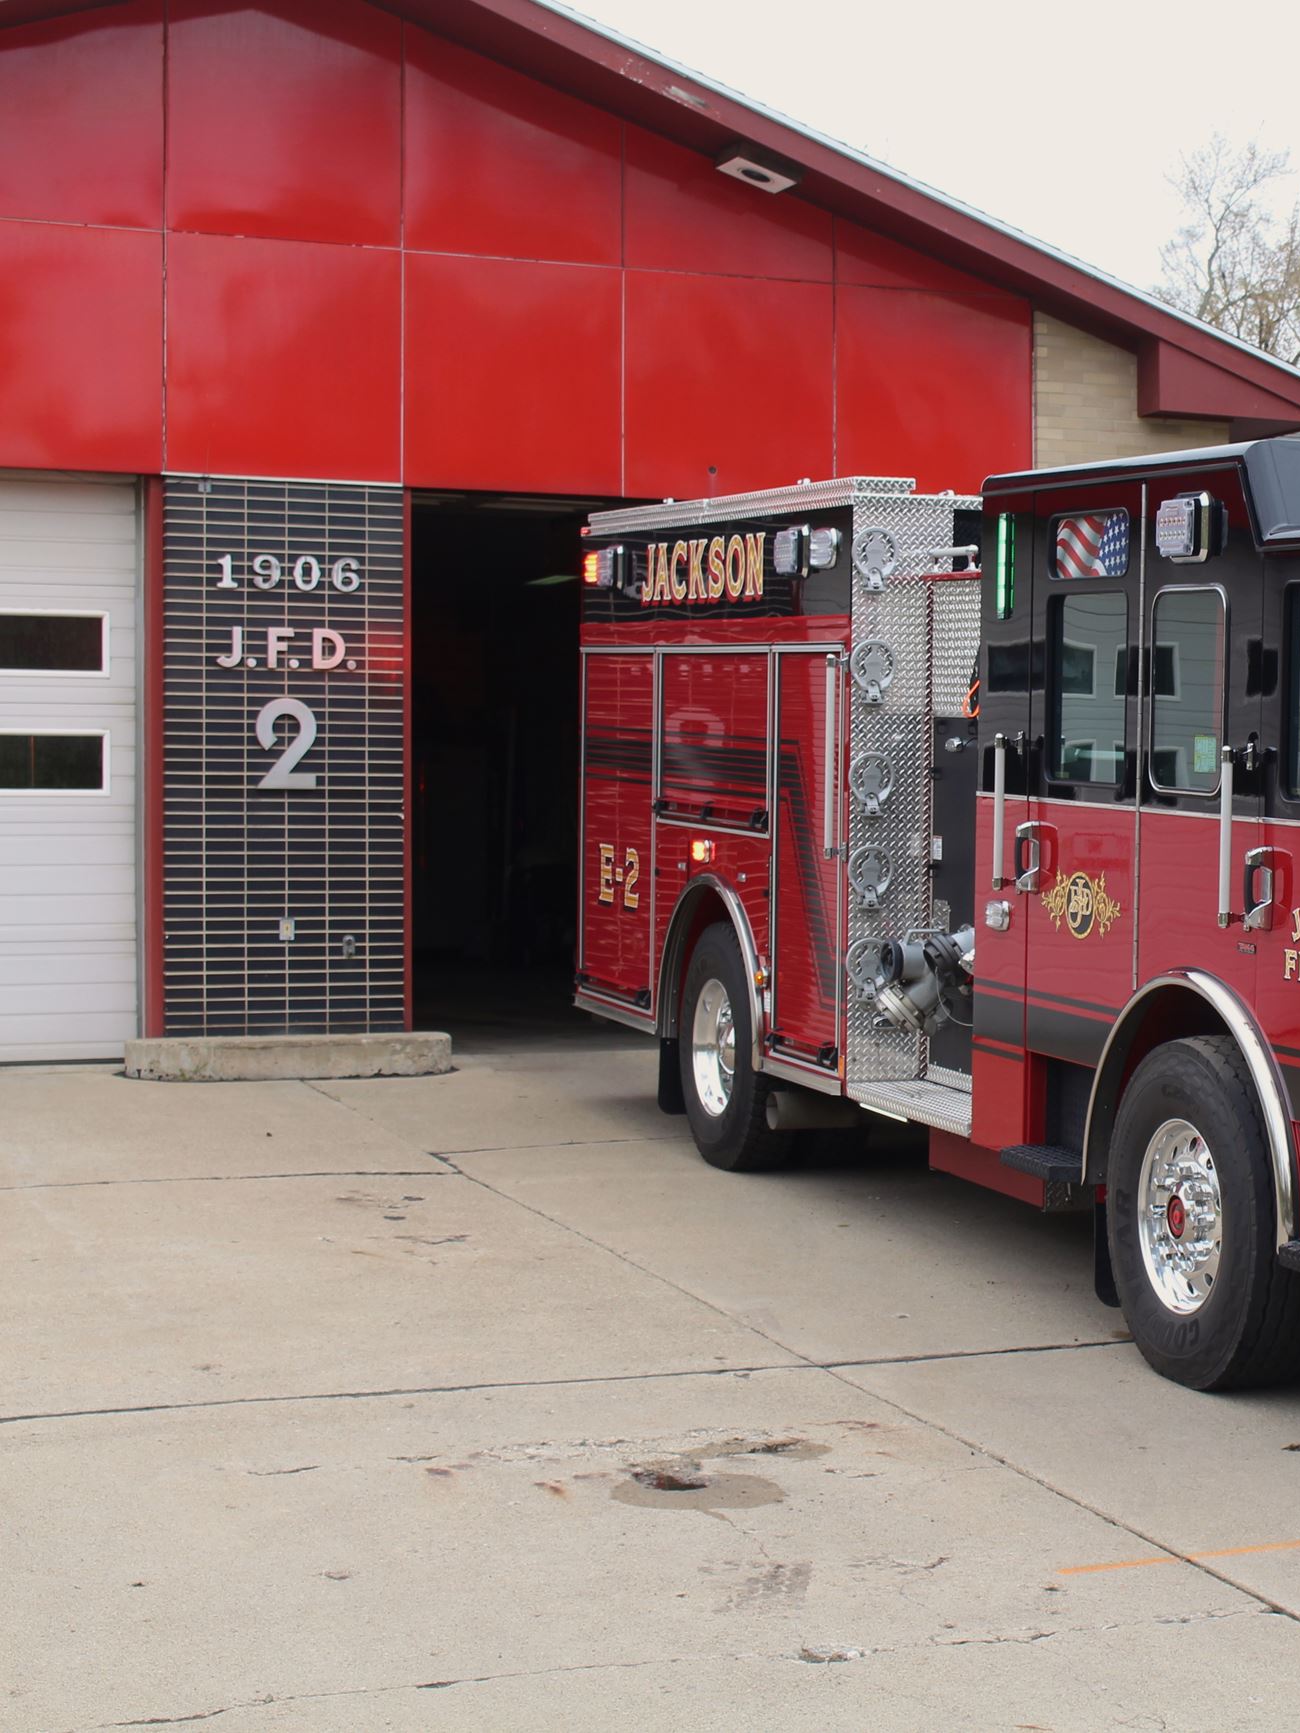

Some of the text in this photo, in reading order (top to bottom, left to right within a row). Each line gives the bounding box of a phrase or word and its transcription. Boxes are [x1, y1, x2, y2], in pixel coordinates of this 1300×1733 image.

[216, 553, 361, 592] 1906
[641, 532, 766, 606] JACKSON
[216, 625, 357, 670] J.F.D.
[255, 697, 317, 789] 2
[598, 843, 640, 912] E-2
